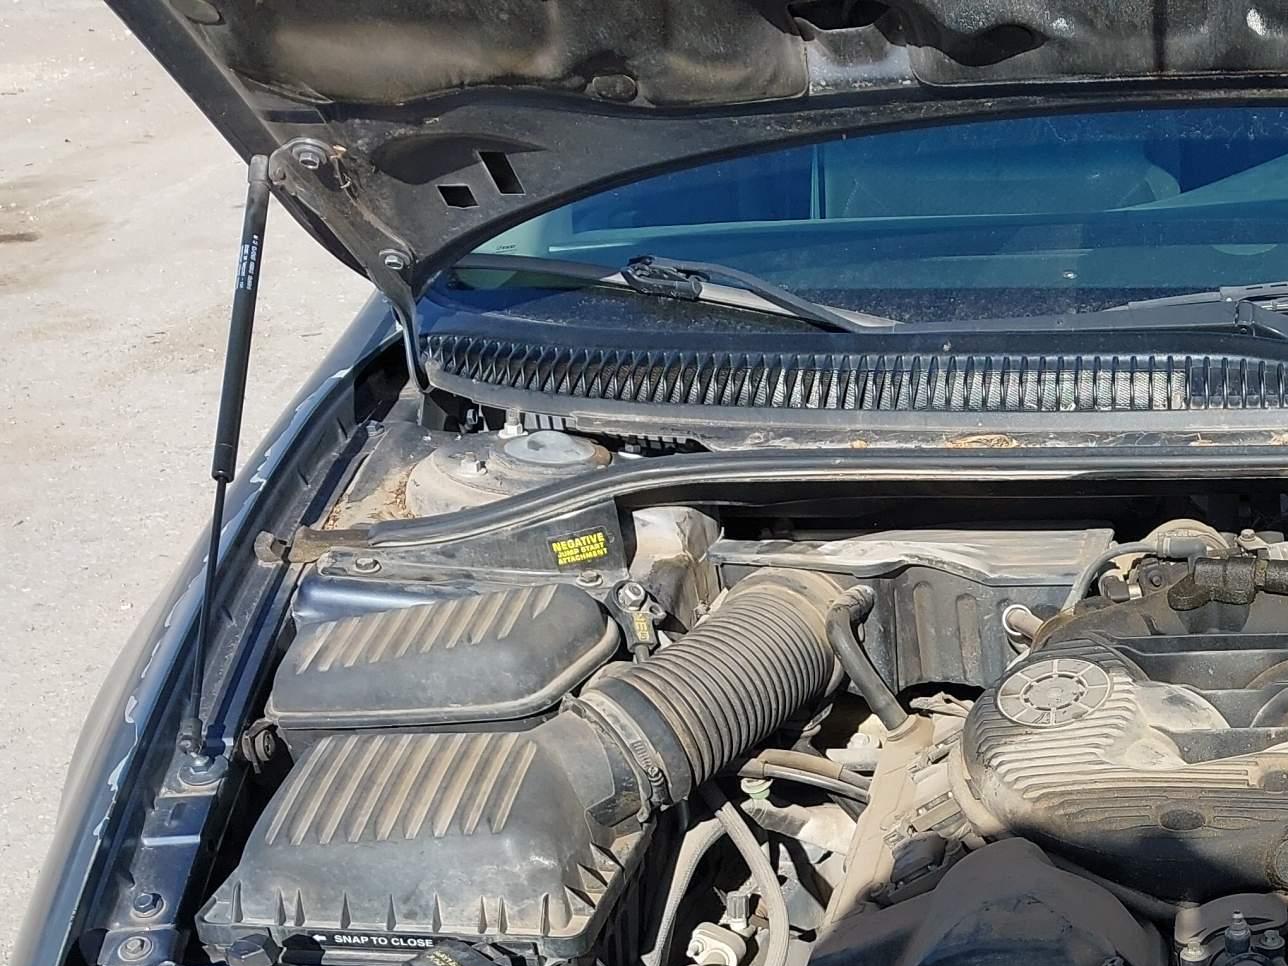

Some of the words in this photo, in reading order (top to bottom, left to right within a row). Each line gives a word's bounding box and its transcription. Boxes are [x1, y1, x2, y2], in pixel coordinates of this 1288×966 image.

[552, 532, 605, 552] NEGATIVE
[558, 548, 580, 558] JUMP
[581, 542, 604, 552] START
[558, 548, 608, 565] ATTACHMENT
[334, 934, 369, 944] SNAP
[370, 936, 388, 945] TO
[391, 938, 434, 947] CLOSE
